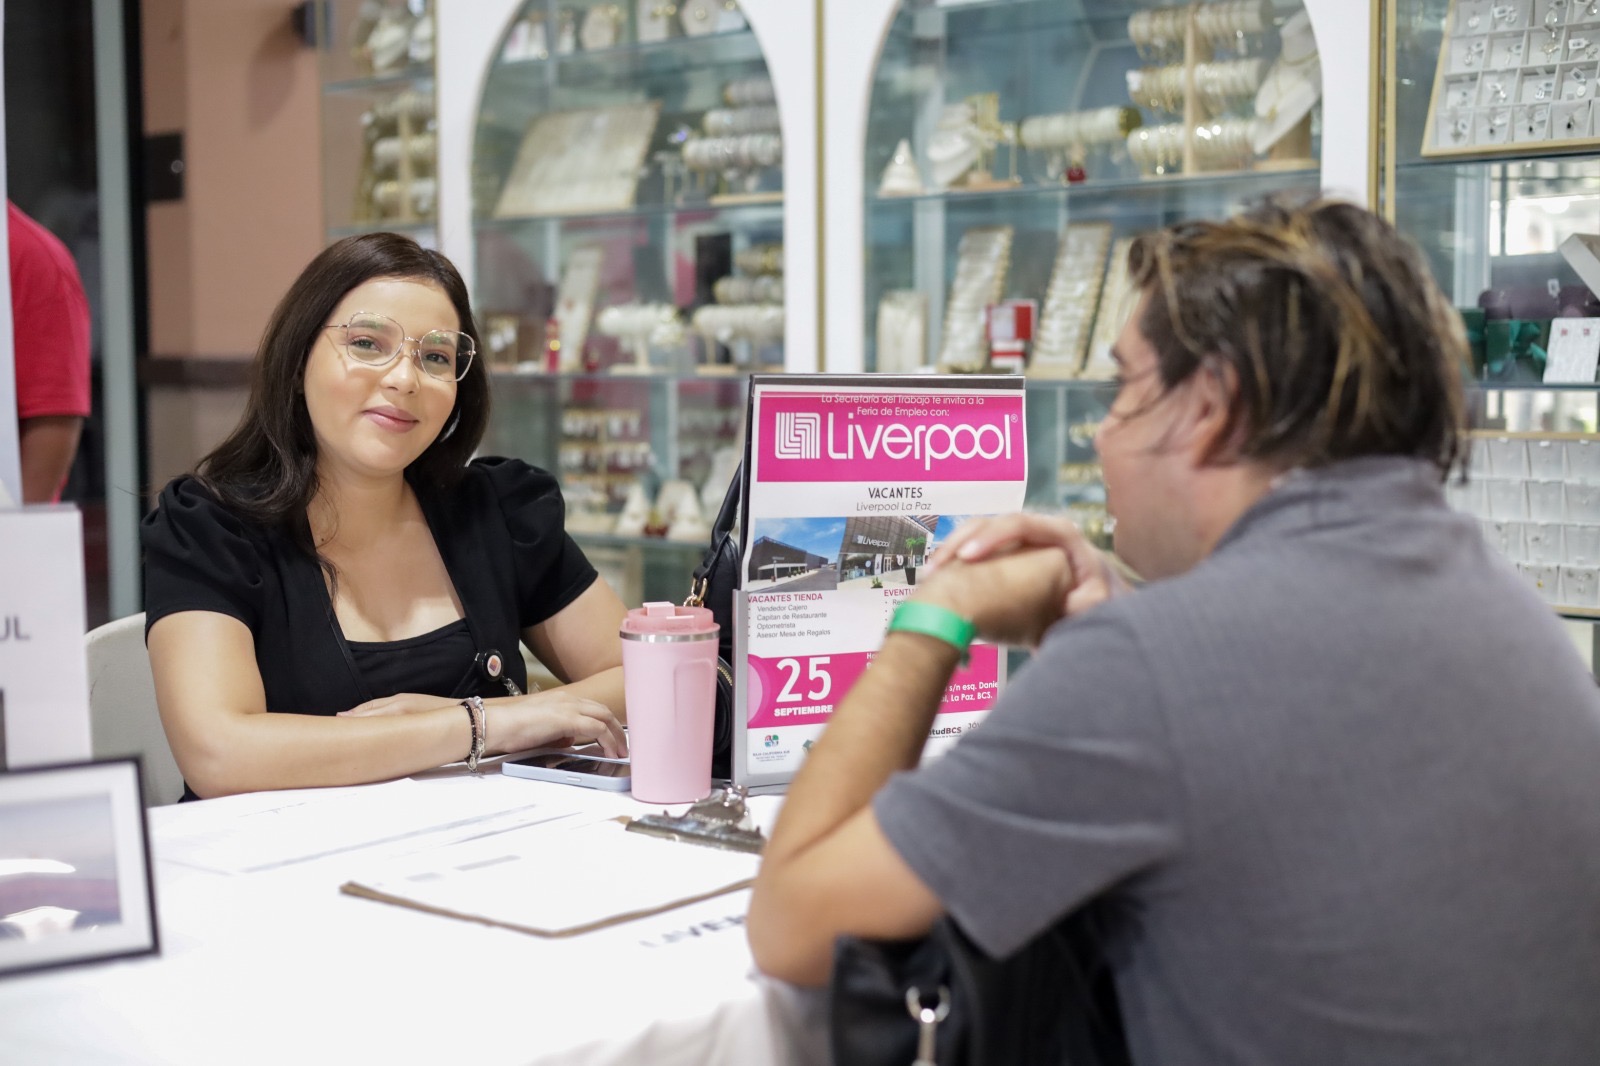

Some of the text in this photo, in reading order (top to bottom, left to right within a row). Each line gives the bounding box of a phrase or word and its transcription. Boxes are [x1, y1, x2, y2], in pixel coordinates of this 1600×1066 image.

[821, 394, 830, 403] La
[882, 395, 896, 404] del
[898, 396, 930, 406] Trabajo
[932, 396, 940, 404] te
[943, 396, 966, 404] invita
[976, 396, 984, 405] la
[857, 407, 950, 418] Feria de Empleo con:
[828, 412, 1012, 470] Liverpool
[868, 487, 922, 498] VACANTES
[856, 502, 932, 512] Liverpool La Paz
[748, 592, 823, 603] VACANTES TIENDA
[757, 622, 796, 630] Optometrista
[806, 629, 831, 638] Regalos
[776, 656, 832, 702] 25
[949, 684, 960, 692] s/n
[977, 692, 992, 700] BCS.
[774, 704, 834, 717] SEPTIEMBRE
